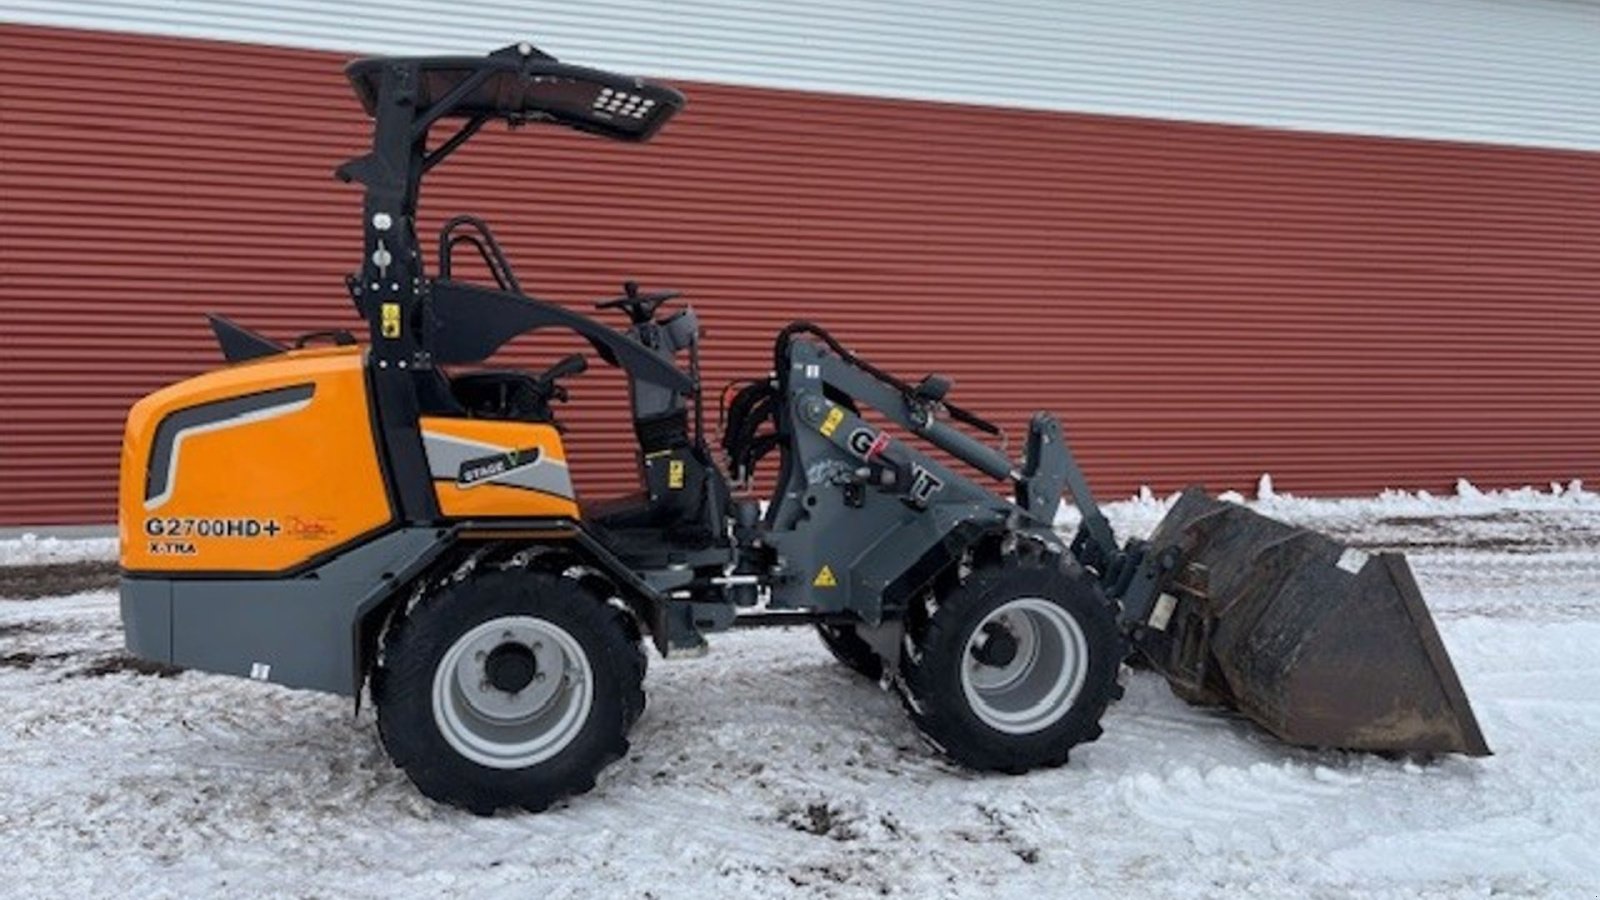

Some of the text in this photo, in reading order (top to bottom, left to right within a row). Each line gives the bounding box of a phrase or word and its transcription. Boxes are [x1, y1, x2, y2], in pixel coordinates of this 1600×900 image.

[464, 460, 504, 481] STAGE
[146, 517, 280, 537] G2700HD+
[150, 543, 196, 554] X-TRA
